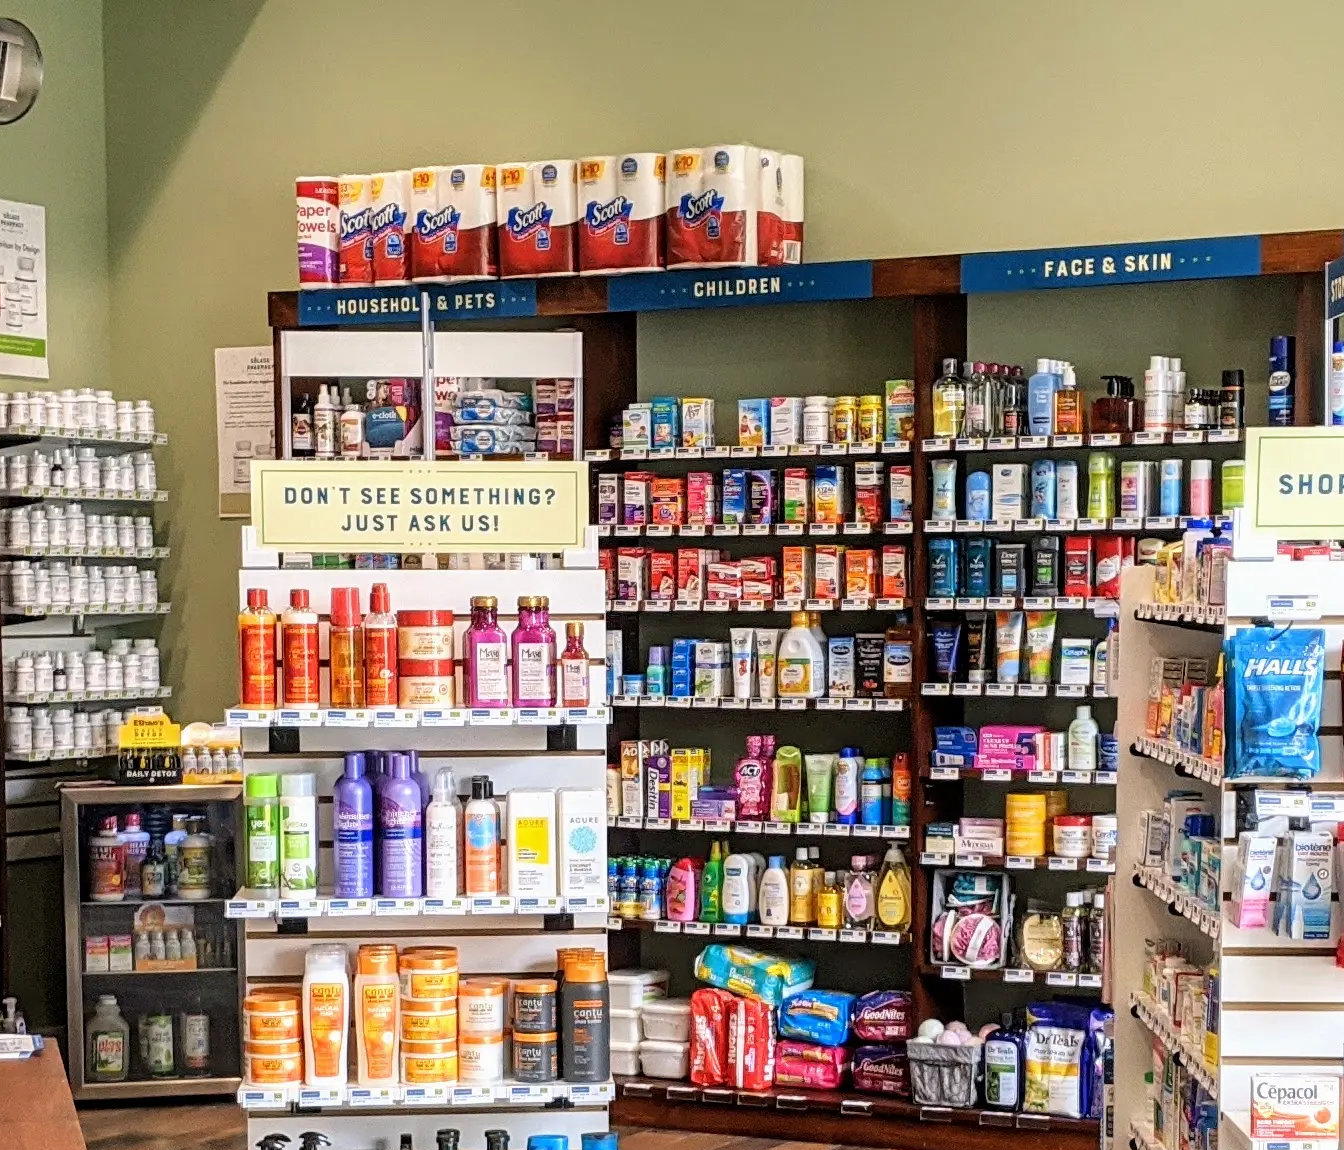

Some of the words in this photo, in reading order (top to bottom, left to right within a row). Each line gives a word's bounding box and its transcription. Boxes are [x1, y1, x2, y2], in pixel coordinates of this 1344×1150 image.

[592, 196, 625, 225] Scott
[686, 189, 717, 218] Scott
[421, 205, 453, 234] Scott
[514, 202, 546, 231] Scott
[1044, 256, 1096, 278] FACE
[1102, 256, 1117, 274] &
[1124, 251, 1172, 274] SKIN
[694, 277, 781, 297] CHILDREN
[336, 294, 430, 316] HOUSEHOL
[437, 297, 449, 310] &
[455, 293, 496, 311] PETS
[284, 486, 351, 505] DON'T
[361, 487, 400, 504] SEE
[410, 487, 556, 505] SOMETHING?
[342, 515, 398, 532] JUST
[408, 515, 452, 532] ASK
[461, 514, 499, 532] US!
[1244, 658, 1318, 678] HALLS
[740, 765, 760, 777] ACT
[648, 768, 659, 811] Desitin
[574, 1009, 603, 1019] cantu
[864, 1009, 905, 1021] GoodNites
[863, 1062, 904, 1076] GoodNites
